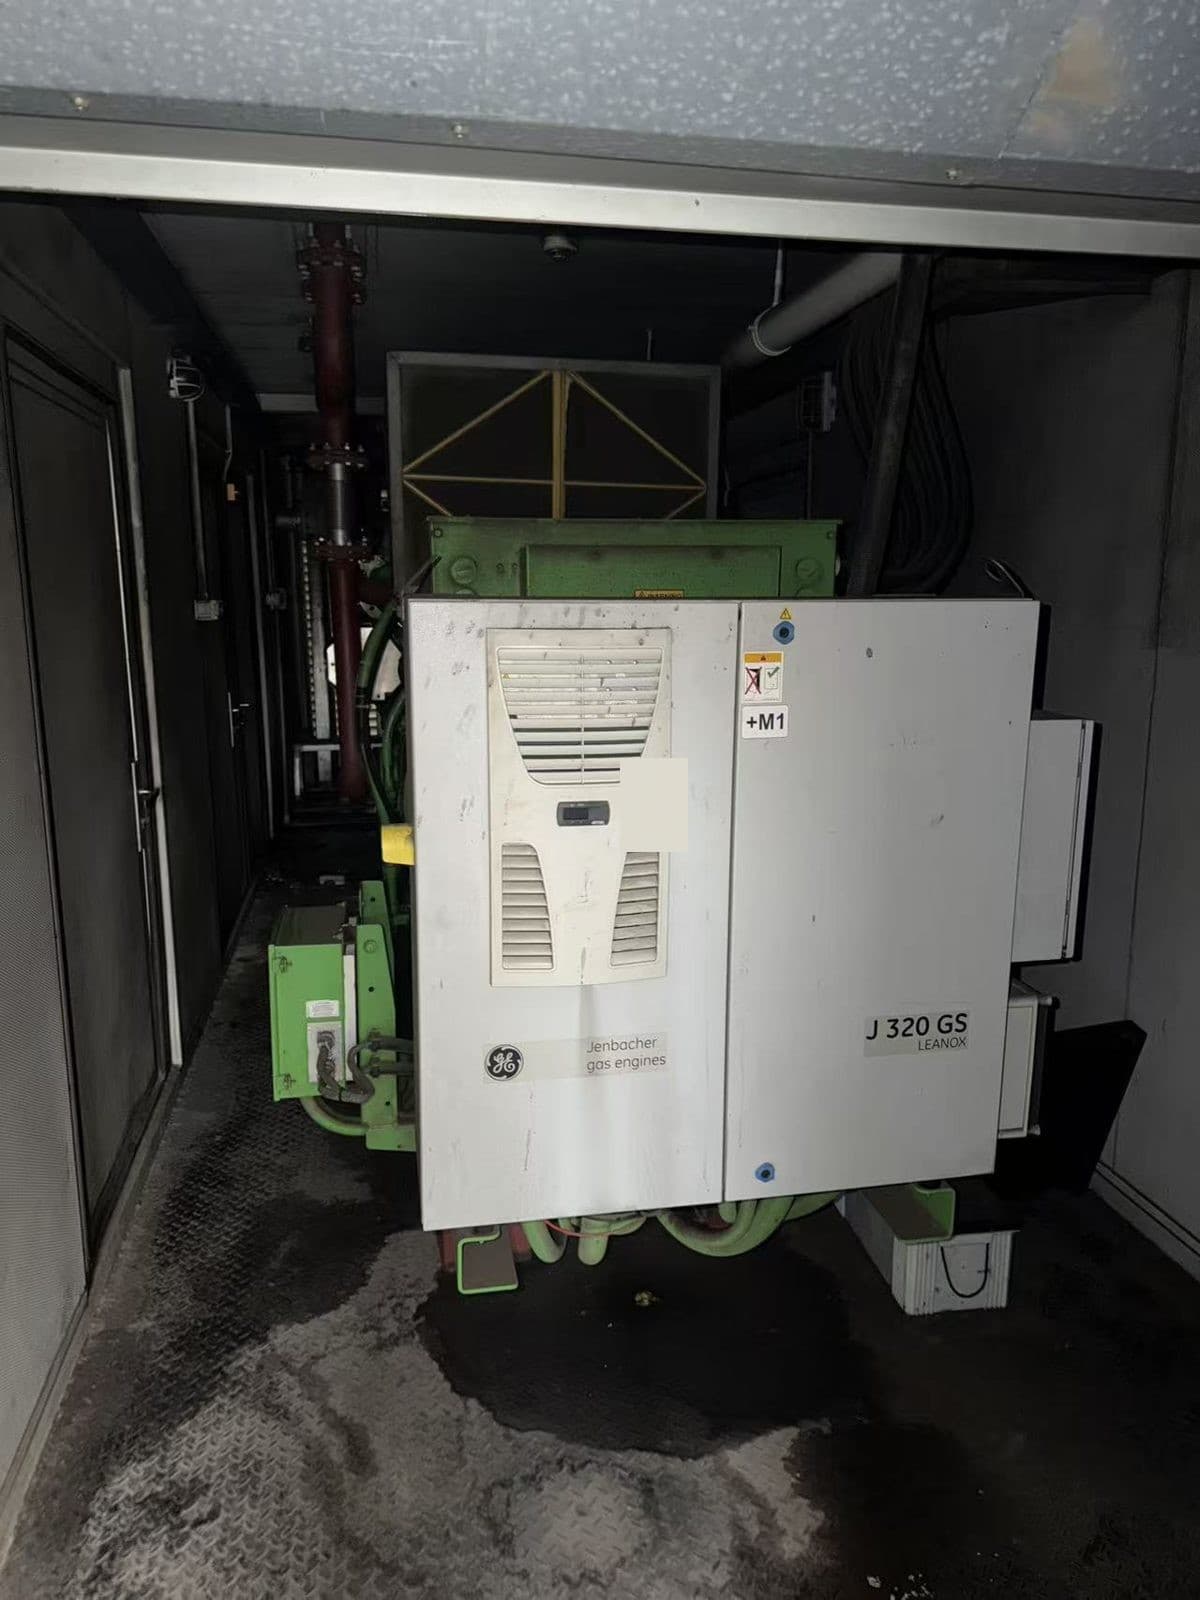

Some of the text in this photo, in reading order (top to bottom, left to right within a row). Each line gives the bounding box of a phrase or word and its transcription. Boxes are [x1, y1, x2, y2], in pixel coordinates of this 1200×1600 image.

[746, 712, 784, 730] +M1
[866, 1013, 968, 1040] J 320 GS
[586, 1038, 658, 1053] Jenbacher
[918, 1036, 968, 1051] LEANOX
[586, 1056, 666, 1073] gas engines
